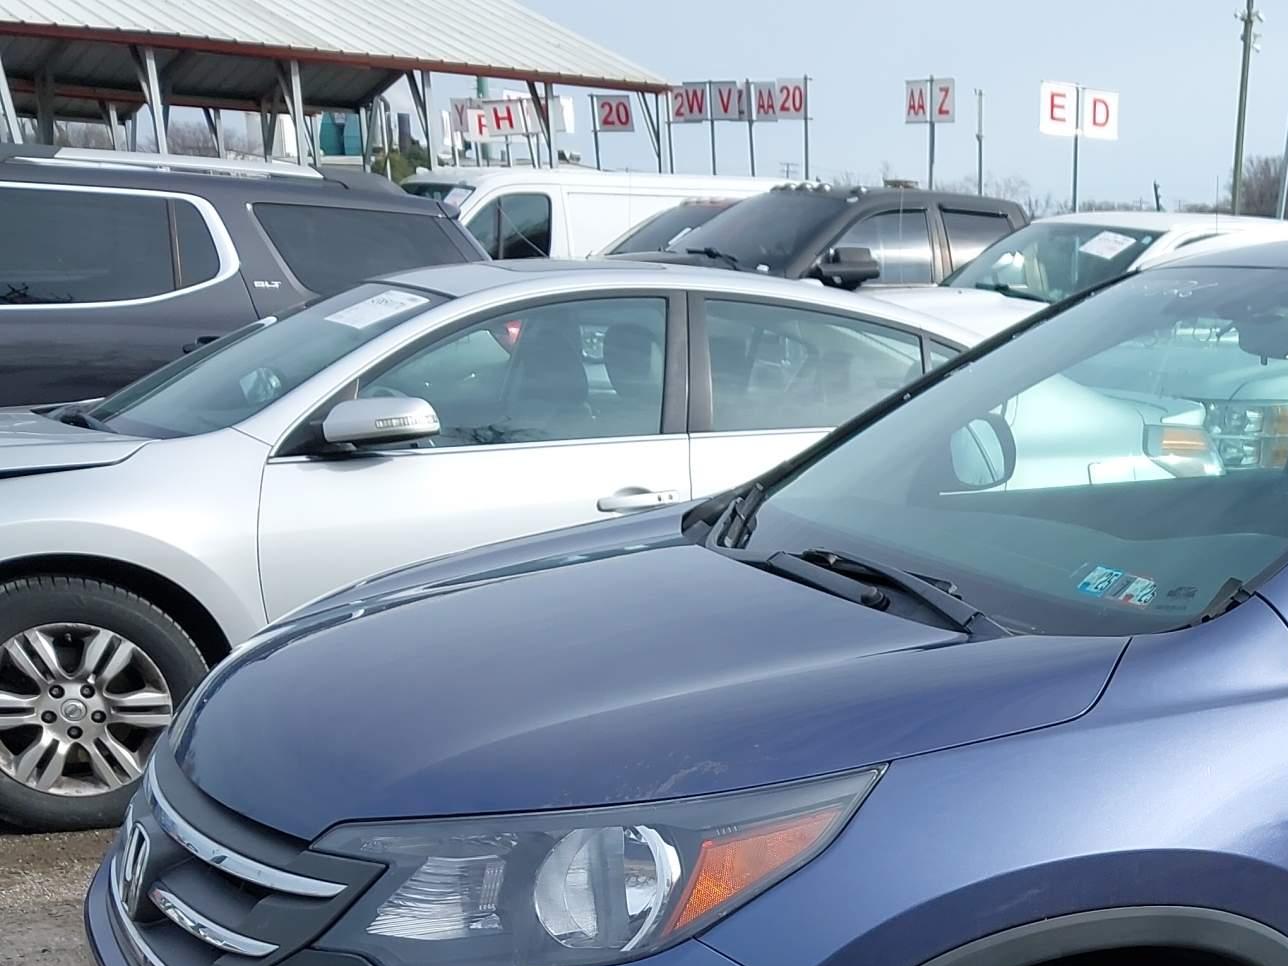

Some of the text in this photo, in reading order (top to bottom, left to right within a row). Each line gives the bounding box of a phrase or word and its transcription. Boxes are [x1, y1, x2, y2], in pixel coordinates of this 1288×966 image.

[684, 88, 705, 114] W
[717, 87, 732, 114] V
[757, 89, 776, 115] AA
[779, 85, 803, 112] 20
[906, 87, 927, 116] AA
[937, 86, 951, 116] Z
[1049, 91, 1067, 123] E
[492, 105, 514, 131] H
[600, 101, 630, 127] 20
[1092, 97, 1110, 128] D
